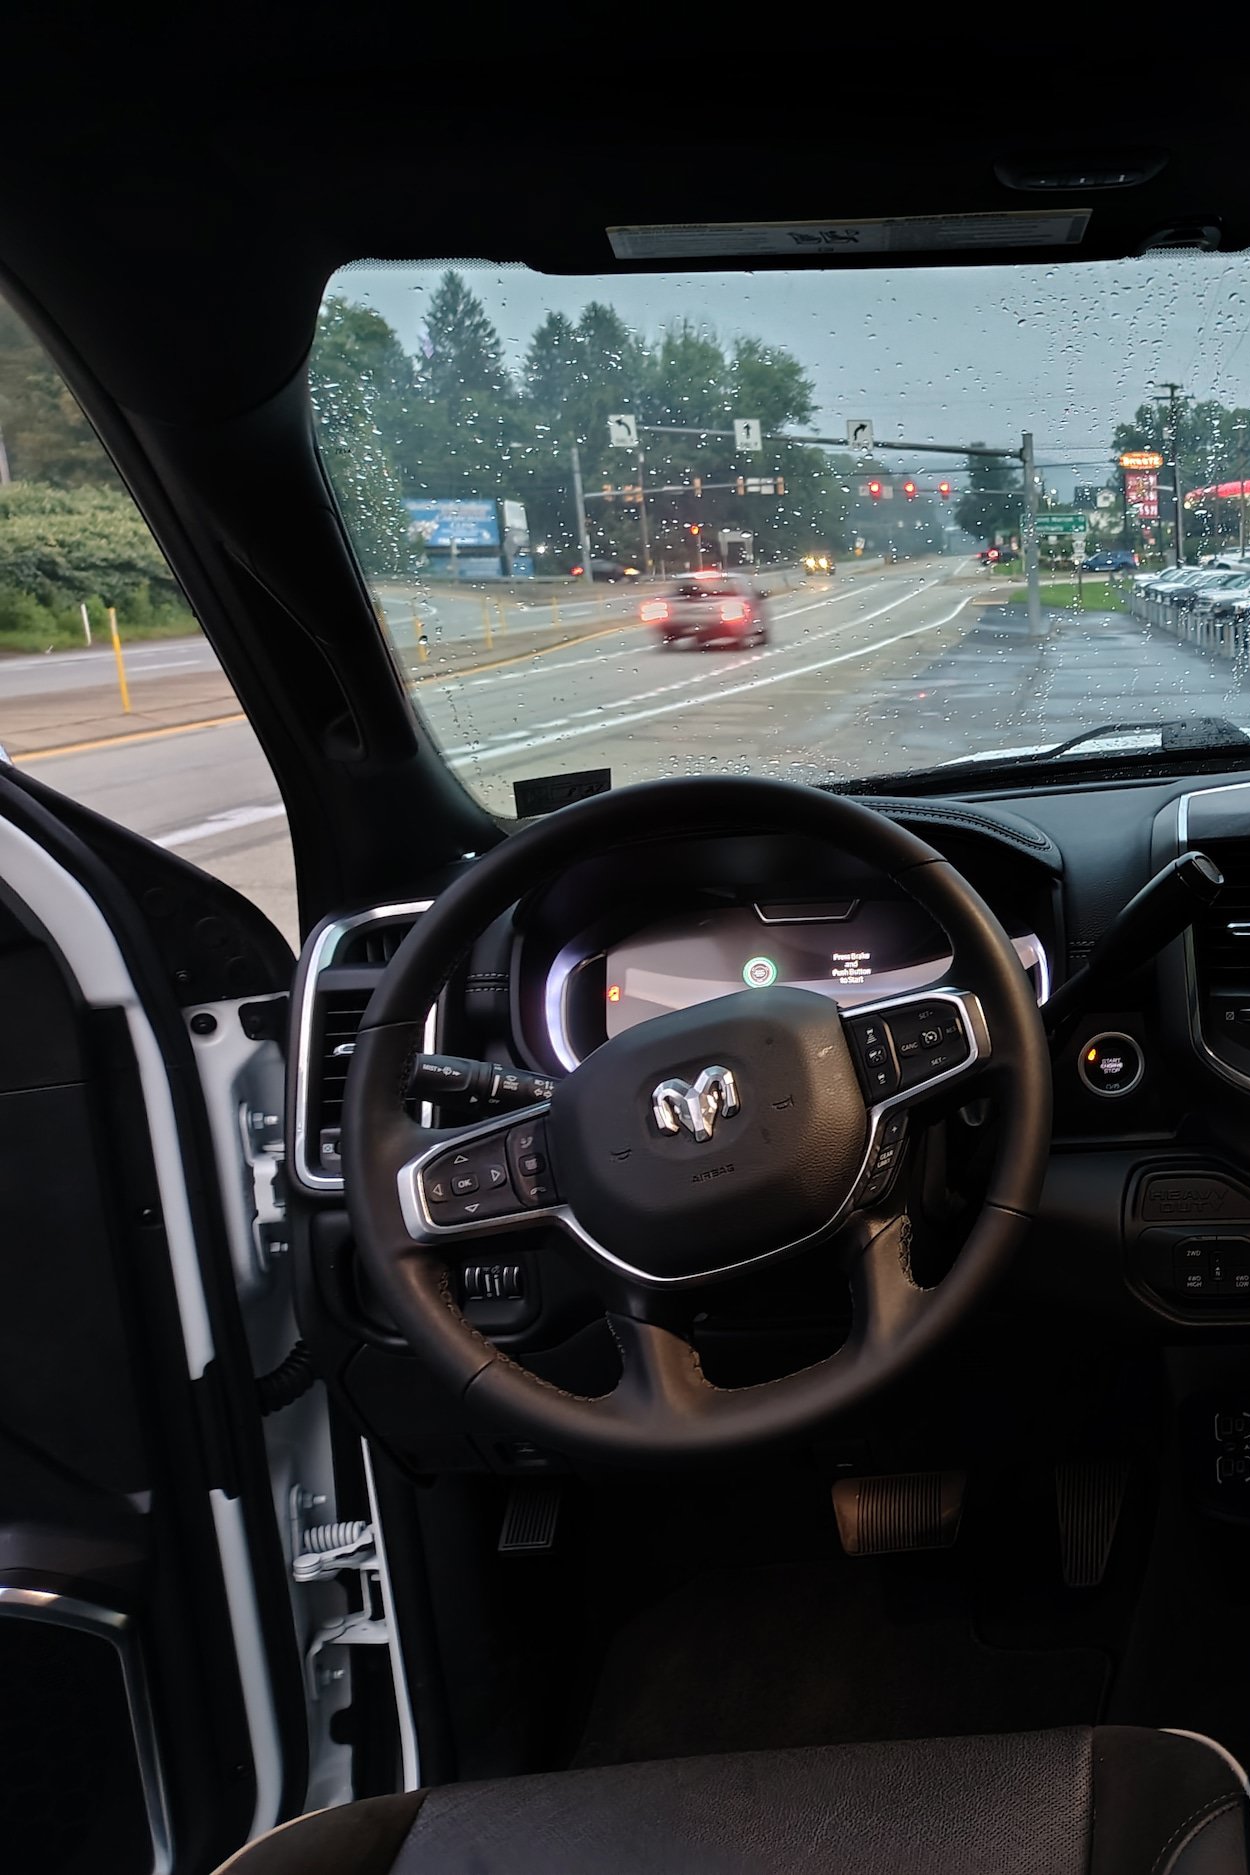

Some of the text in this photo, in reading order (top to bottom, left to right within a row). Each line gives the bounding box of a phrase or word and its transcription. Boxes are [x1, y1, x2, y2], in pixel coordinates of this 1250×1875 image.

[851, 952, 871, 960] Brake
[844, 960, 858, 968] and
[849, 968, 871, 976] Button
[901, 1041, 919, 1052] CANC
[880, 1149, 894, 1160] GEAR
[692, 1163, 735, 1183] AIRBAG
[458, 1178, 472, 1188] OK
[1151, 1189, 1228, 1200] HEAVY
[1160, 1201, 1224, 1213] DUTY
